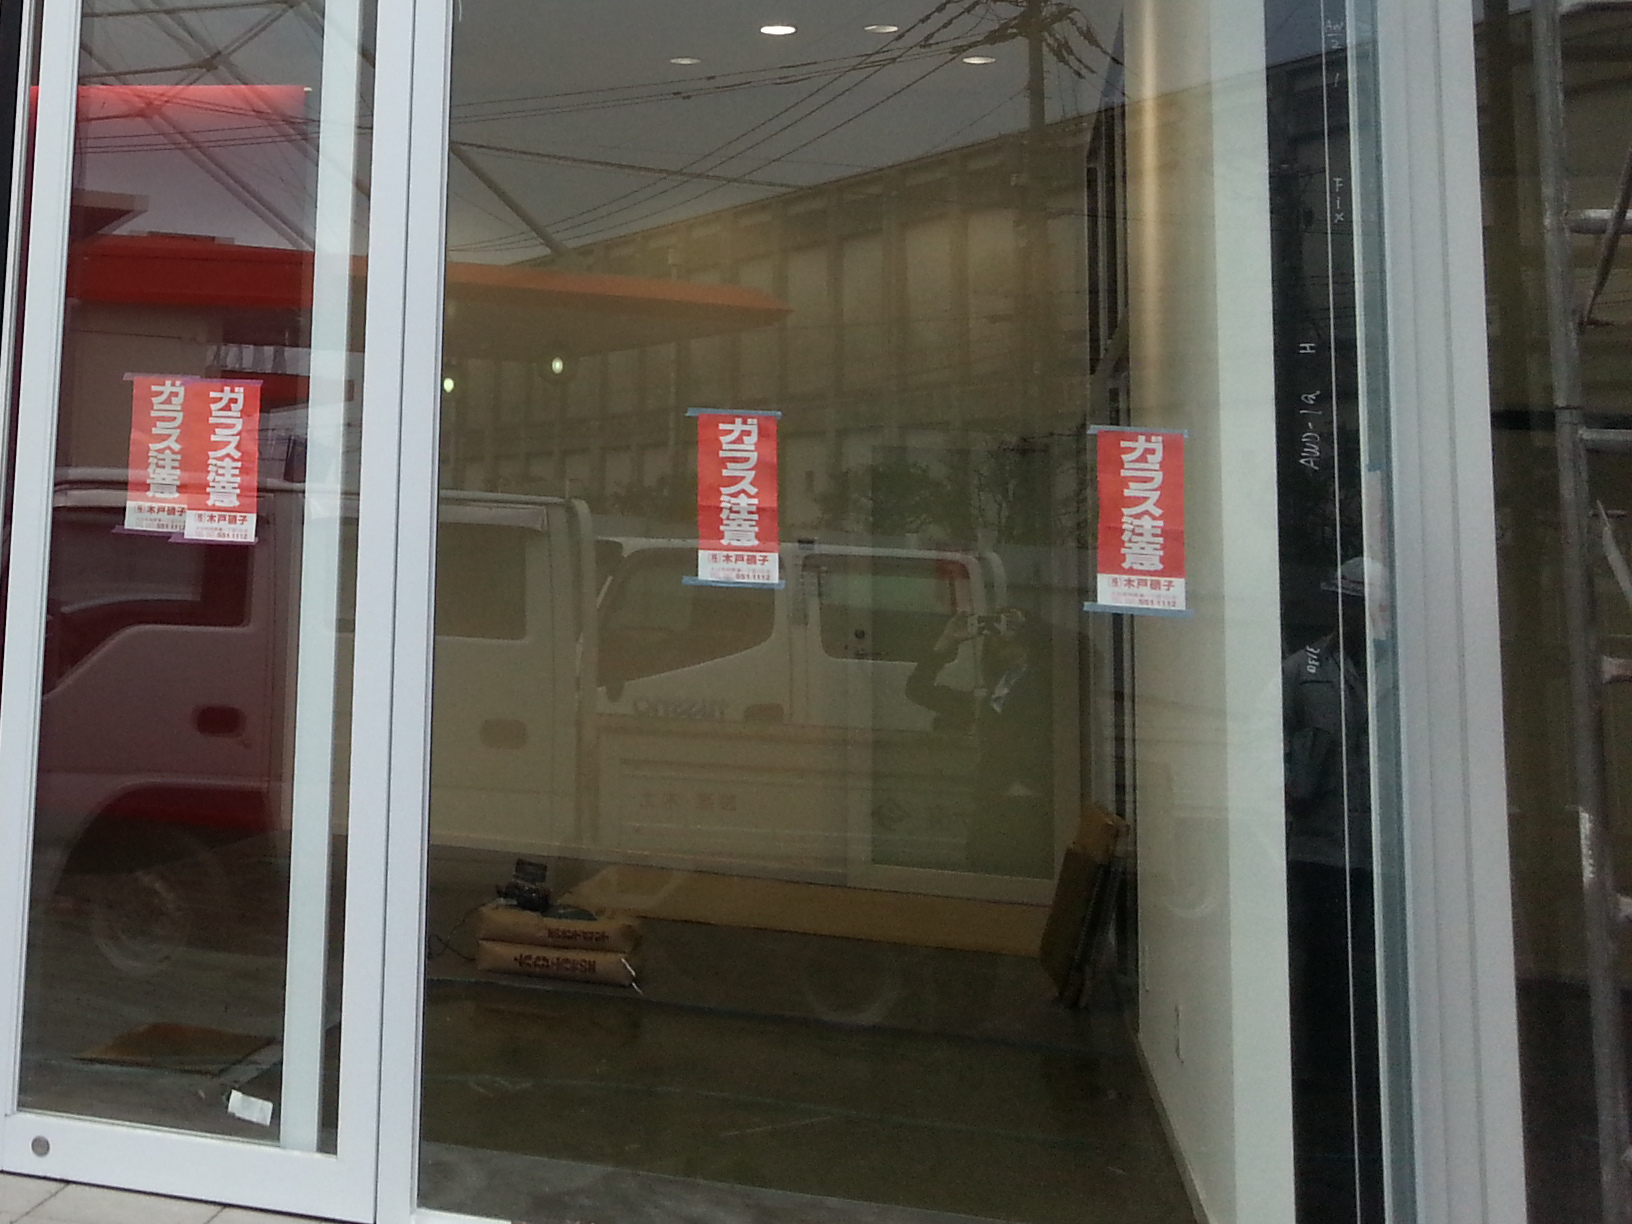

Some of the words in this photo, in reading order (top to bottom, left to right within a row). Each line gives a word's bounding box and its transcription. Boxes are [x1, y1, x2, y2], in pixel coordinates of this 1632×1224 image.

[146, 380, 185, 499] ガラス注意
[206, 386, 245, 508] ガラス注意
[719, 418, 760, 547] ガラス注意
[1120, 435, 1164, 571] ガラス注意
